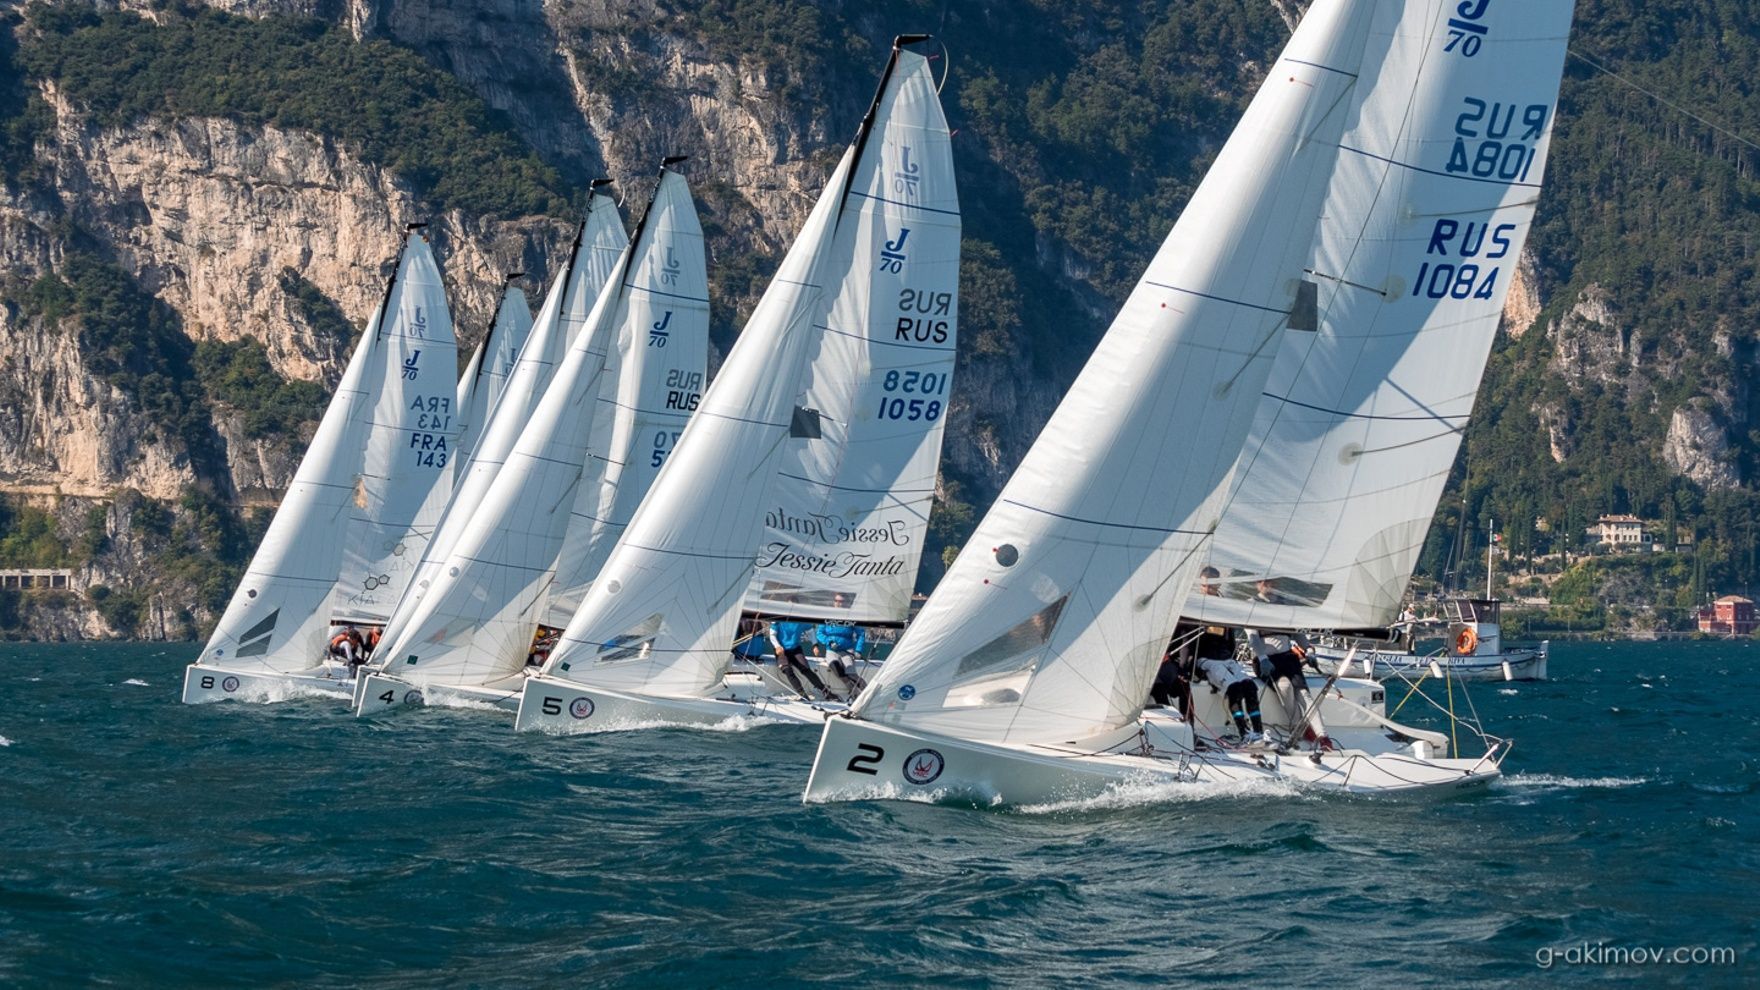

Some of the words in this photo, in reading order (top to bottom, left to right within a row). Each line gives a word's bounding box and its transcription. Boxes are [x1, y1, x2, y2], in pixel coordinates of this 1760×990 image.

[1443, 29, 1482, 58] 70
[885, 228, 911, 252] J
[1426, 219, 1516, 259] RUS
[879, 257, 903, 275] 70
[1412, 262, 1499, 300] 1084
[653, 311, 673, 331] J
[895, 317, 949, 344] RUS
[648, 335, 667, 349] 70
[405, 349, 421, 366] J
[402, 369, 418, 381] 70
[665, 391, 701, 412] RUS
[878, 396, 942, 422] 1058
[410, 432, 447, 452] FRA
[416, 450, 447, 469] 143
[754, 542, 837, 574] Jessie
[828, 551, 904, 579] Tanta
[200, 675, 216, 690] 8
[379, 689, 395, 705] 4
[541, 696, 563, 716] 5
[846, 742, 885, 776] 2
